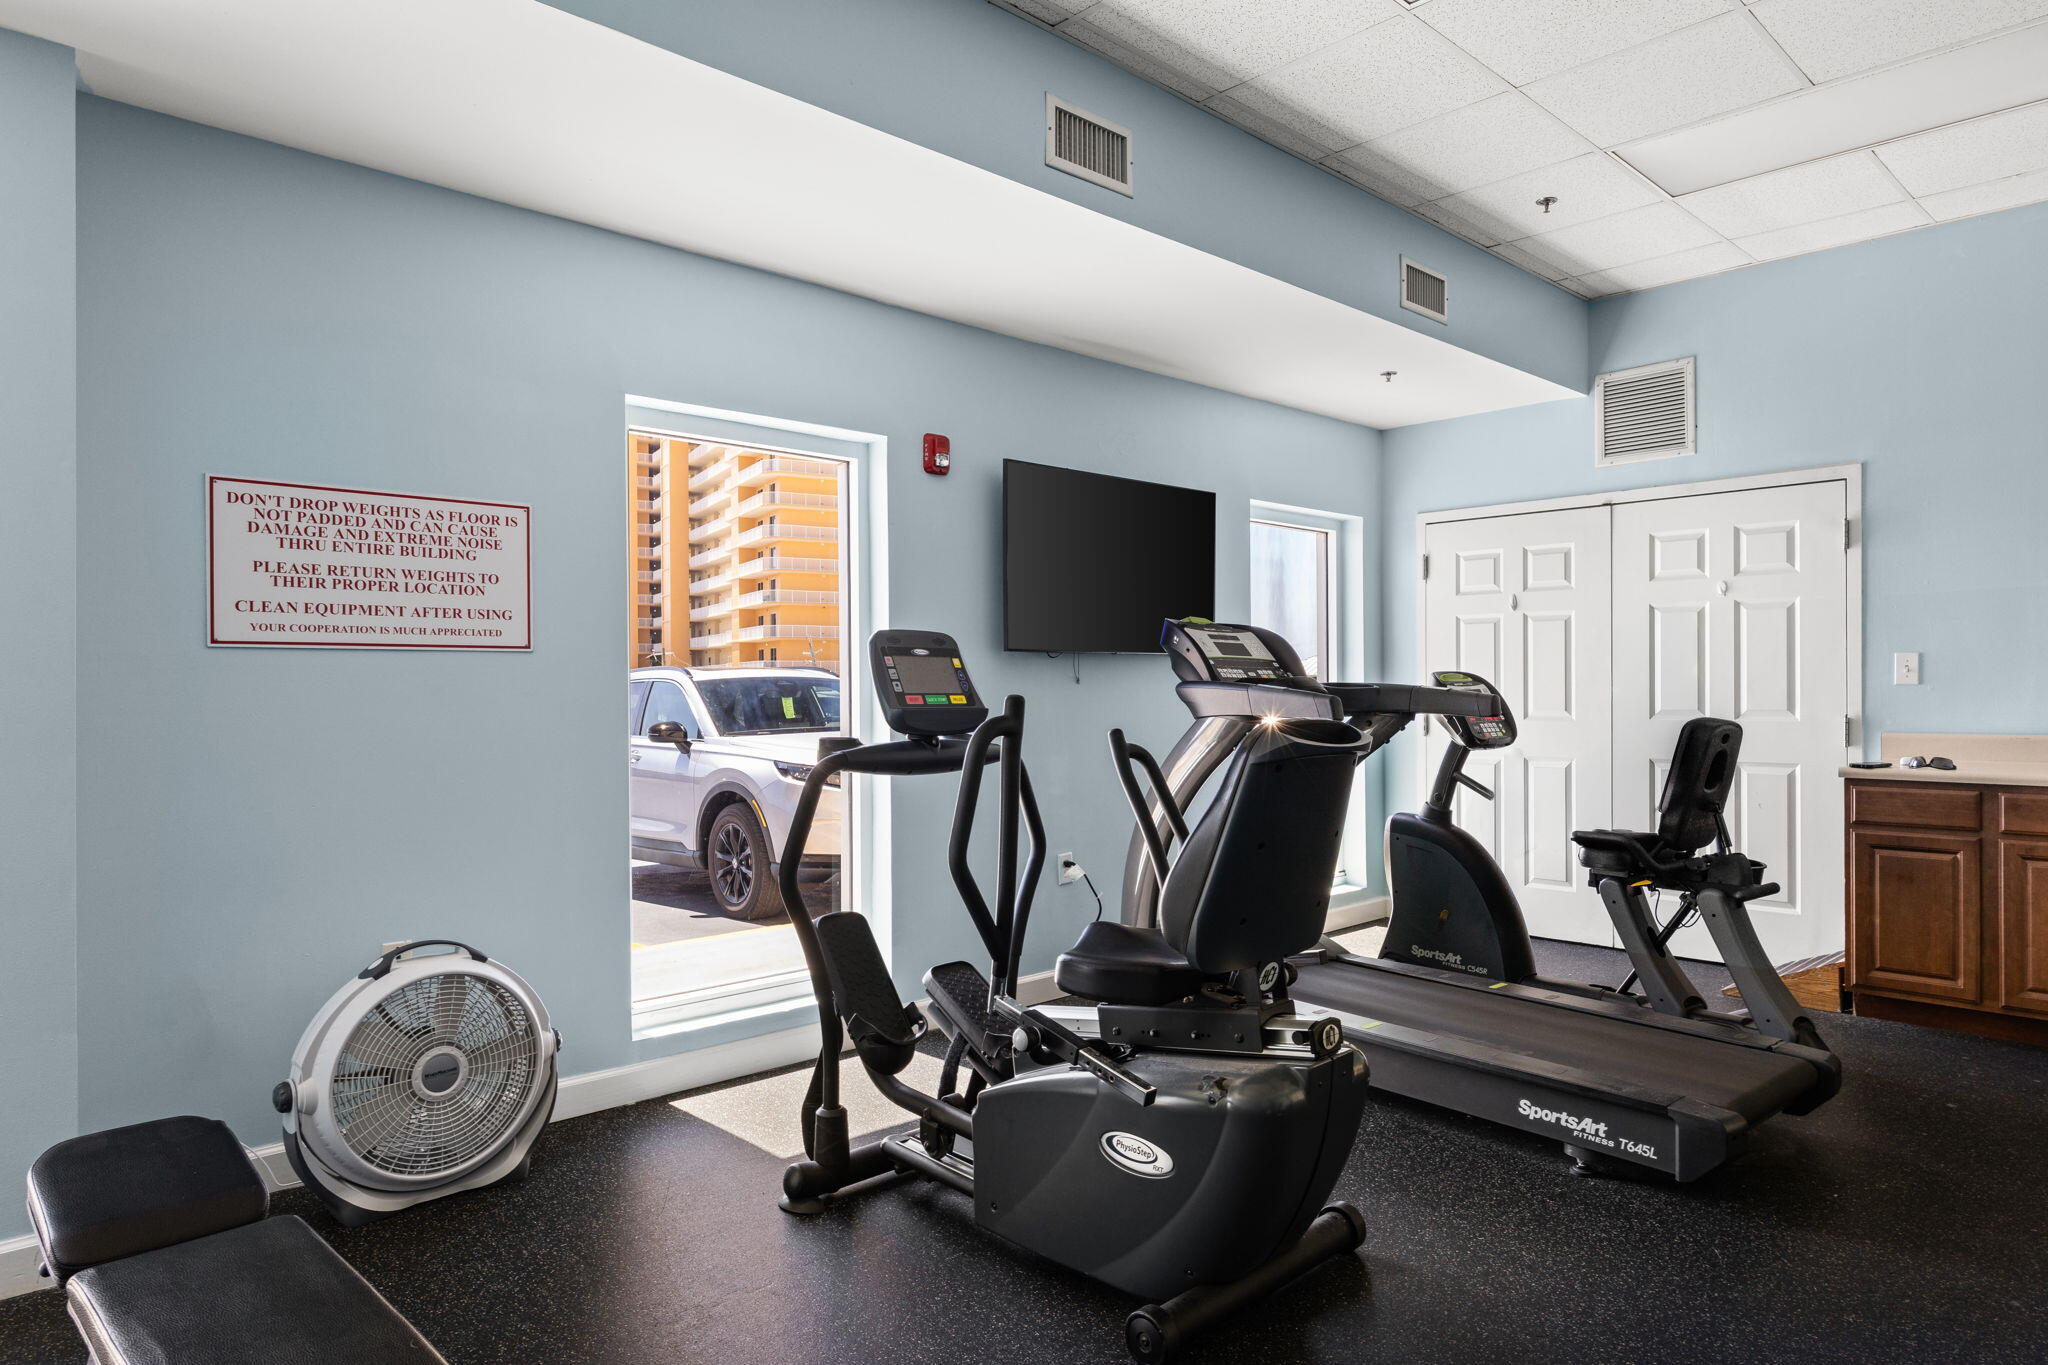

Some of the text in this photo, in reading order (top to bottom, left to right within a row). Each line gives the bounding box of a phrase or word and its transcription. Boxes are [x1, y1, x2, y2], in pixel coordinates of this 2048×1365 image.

[226, 491, 518, 527] DON'T DROP WEIGHTS AS FLOOR IS
[254, 507, 497, 538] NOT PADDED AND CAN CAUSE
[247, 521, 503, 550] DAMAGE AND EXTREME NOISE
[276, 536, 478, 561] THRU ENTIRE BUILDING
[253, 560, 499, 585] PLEASE RETURN WEIGHTS TO
[270, 575, 486, 597] THEIR PROPER LOCATION
[235, 599, 513, 621] CLEAN EQUIPMENT AFTER USING
[249, 622, 503, 638] YOUR COOPERATION IS MUCH APPRECIATED
[1411, 944, 1462, 964] SportsArt
[1442, 961, 1466, 970] FITNESS
[1518, 1099, 1608, 1137] SportsArt
[1116, 1139, 1152, 1160] PhysioStep
[1573, 1130, 1658, 1160] FITNESS T645L
